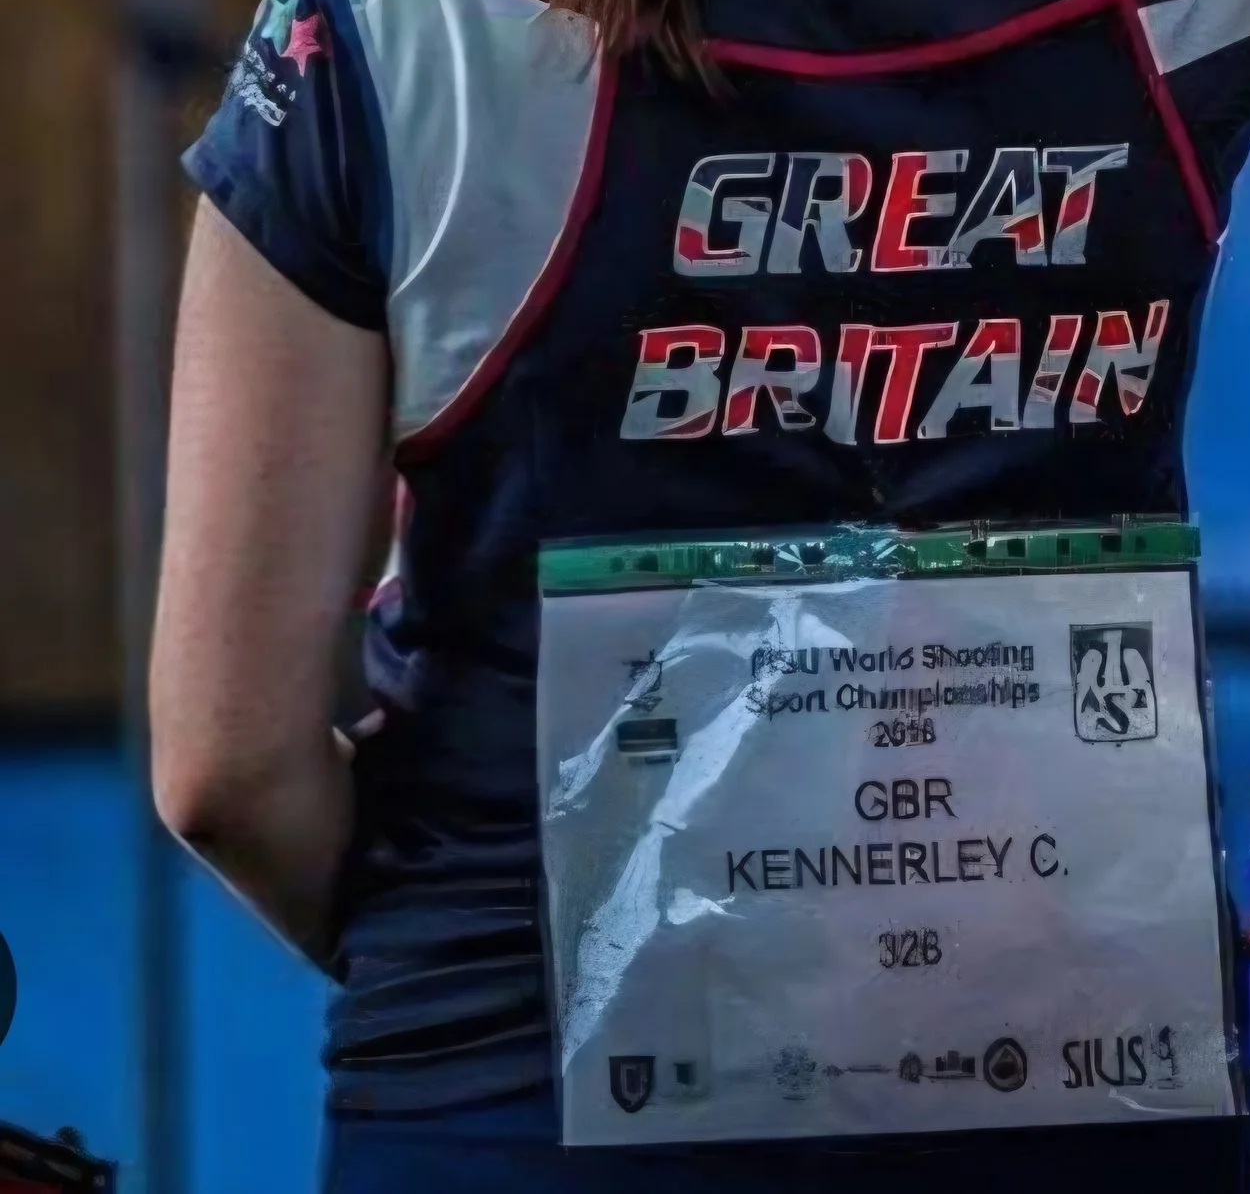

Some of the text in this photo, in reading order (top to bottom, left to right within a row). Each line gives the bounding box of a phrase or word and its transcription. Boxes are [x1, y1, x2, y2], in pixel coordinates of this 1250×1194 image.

[673, 143, 1129, 276] GREAT
[619, 299, 1170, 445] BRITAIN
[855, 778, 957, 820] GBR
[727, 833, 1069, 892] KENNERLEY C.
[1061, 1034, 1148, 1089] SIUS
